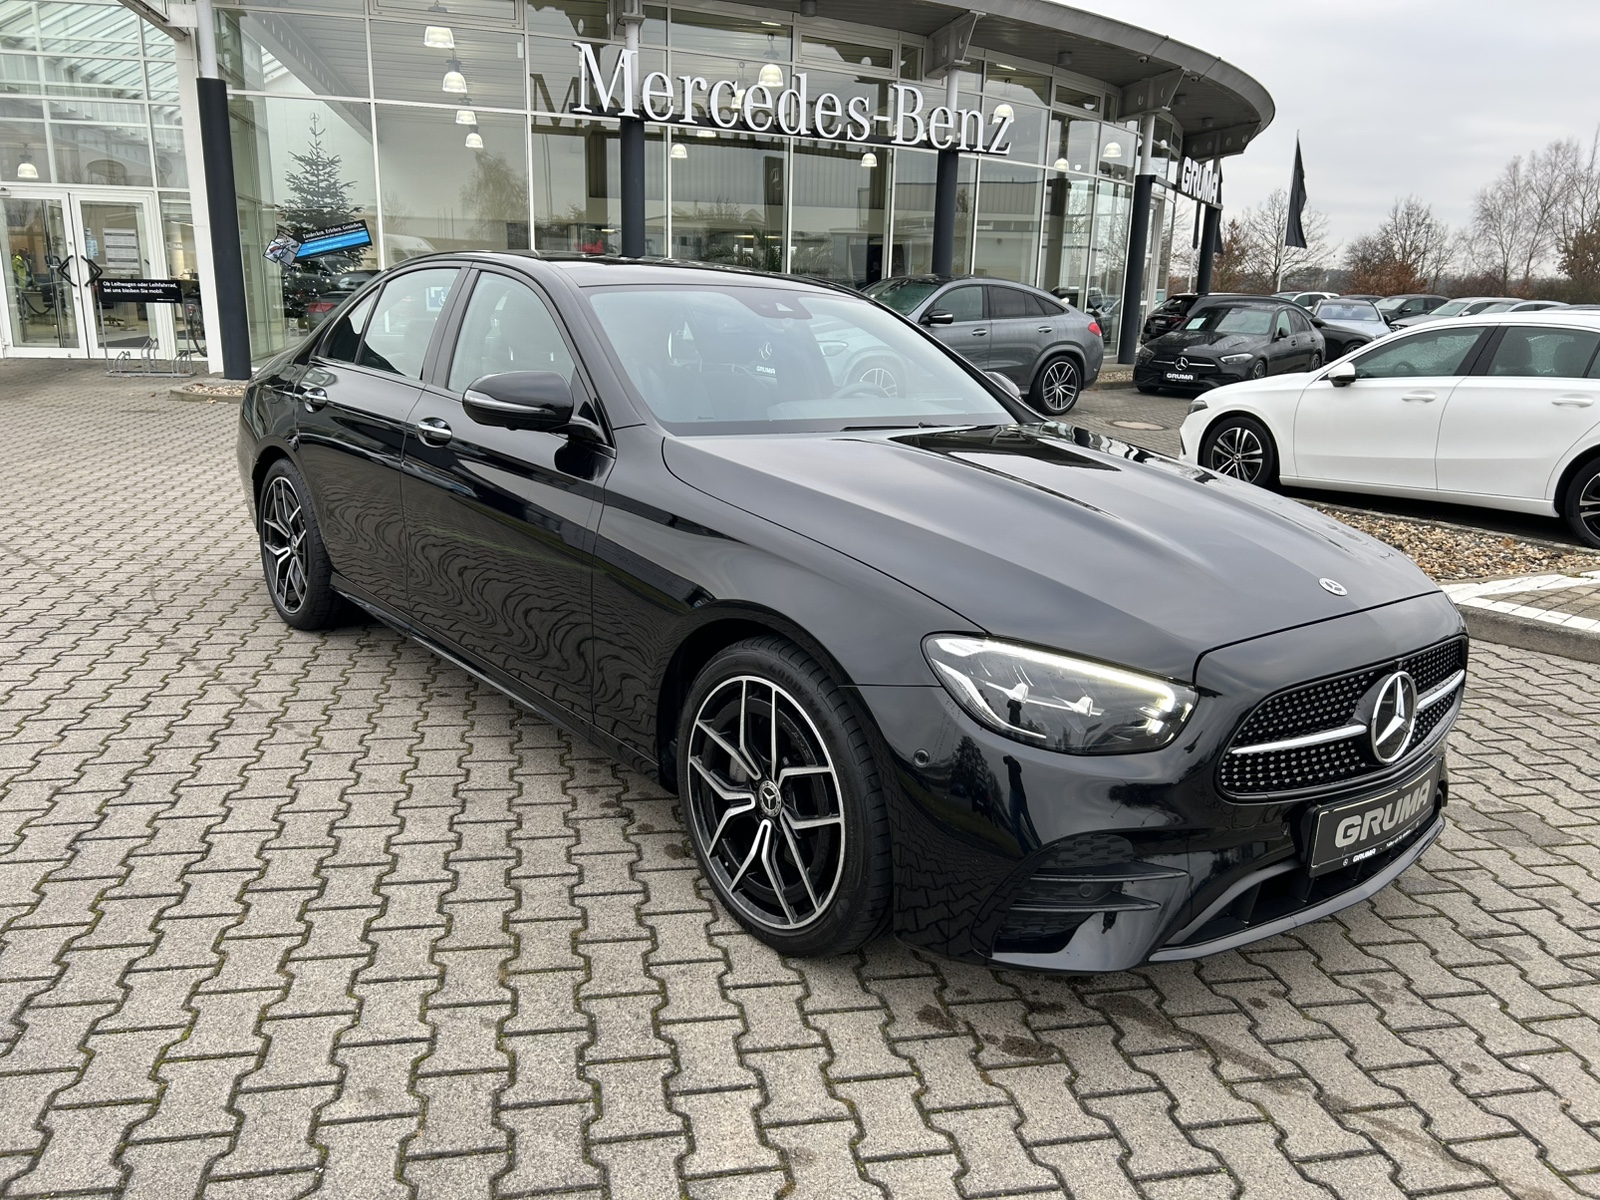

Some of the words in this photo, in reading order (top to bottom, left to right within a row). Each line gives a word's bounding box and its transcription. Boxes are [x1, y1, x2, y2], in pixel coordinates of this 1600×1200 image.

[572, 42, 1013, 155] Mercedes-Benz
[1181, 156, 1220, 204] GRUMA
[756, 365, 776, 375] GRUMA
[1166, 372, 1194, 381] GRUMA
[1334, 779, 1431, 848] GRUMA
[1352, 848, 1377, 862] GRUMA
